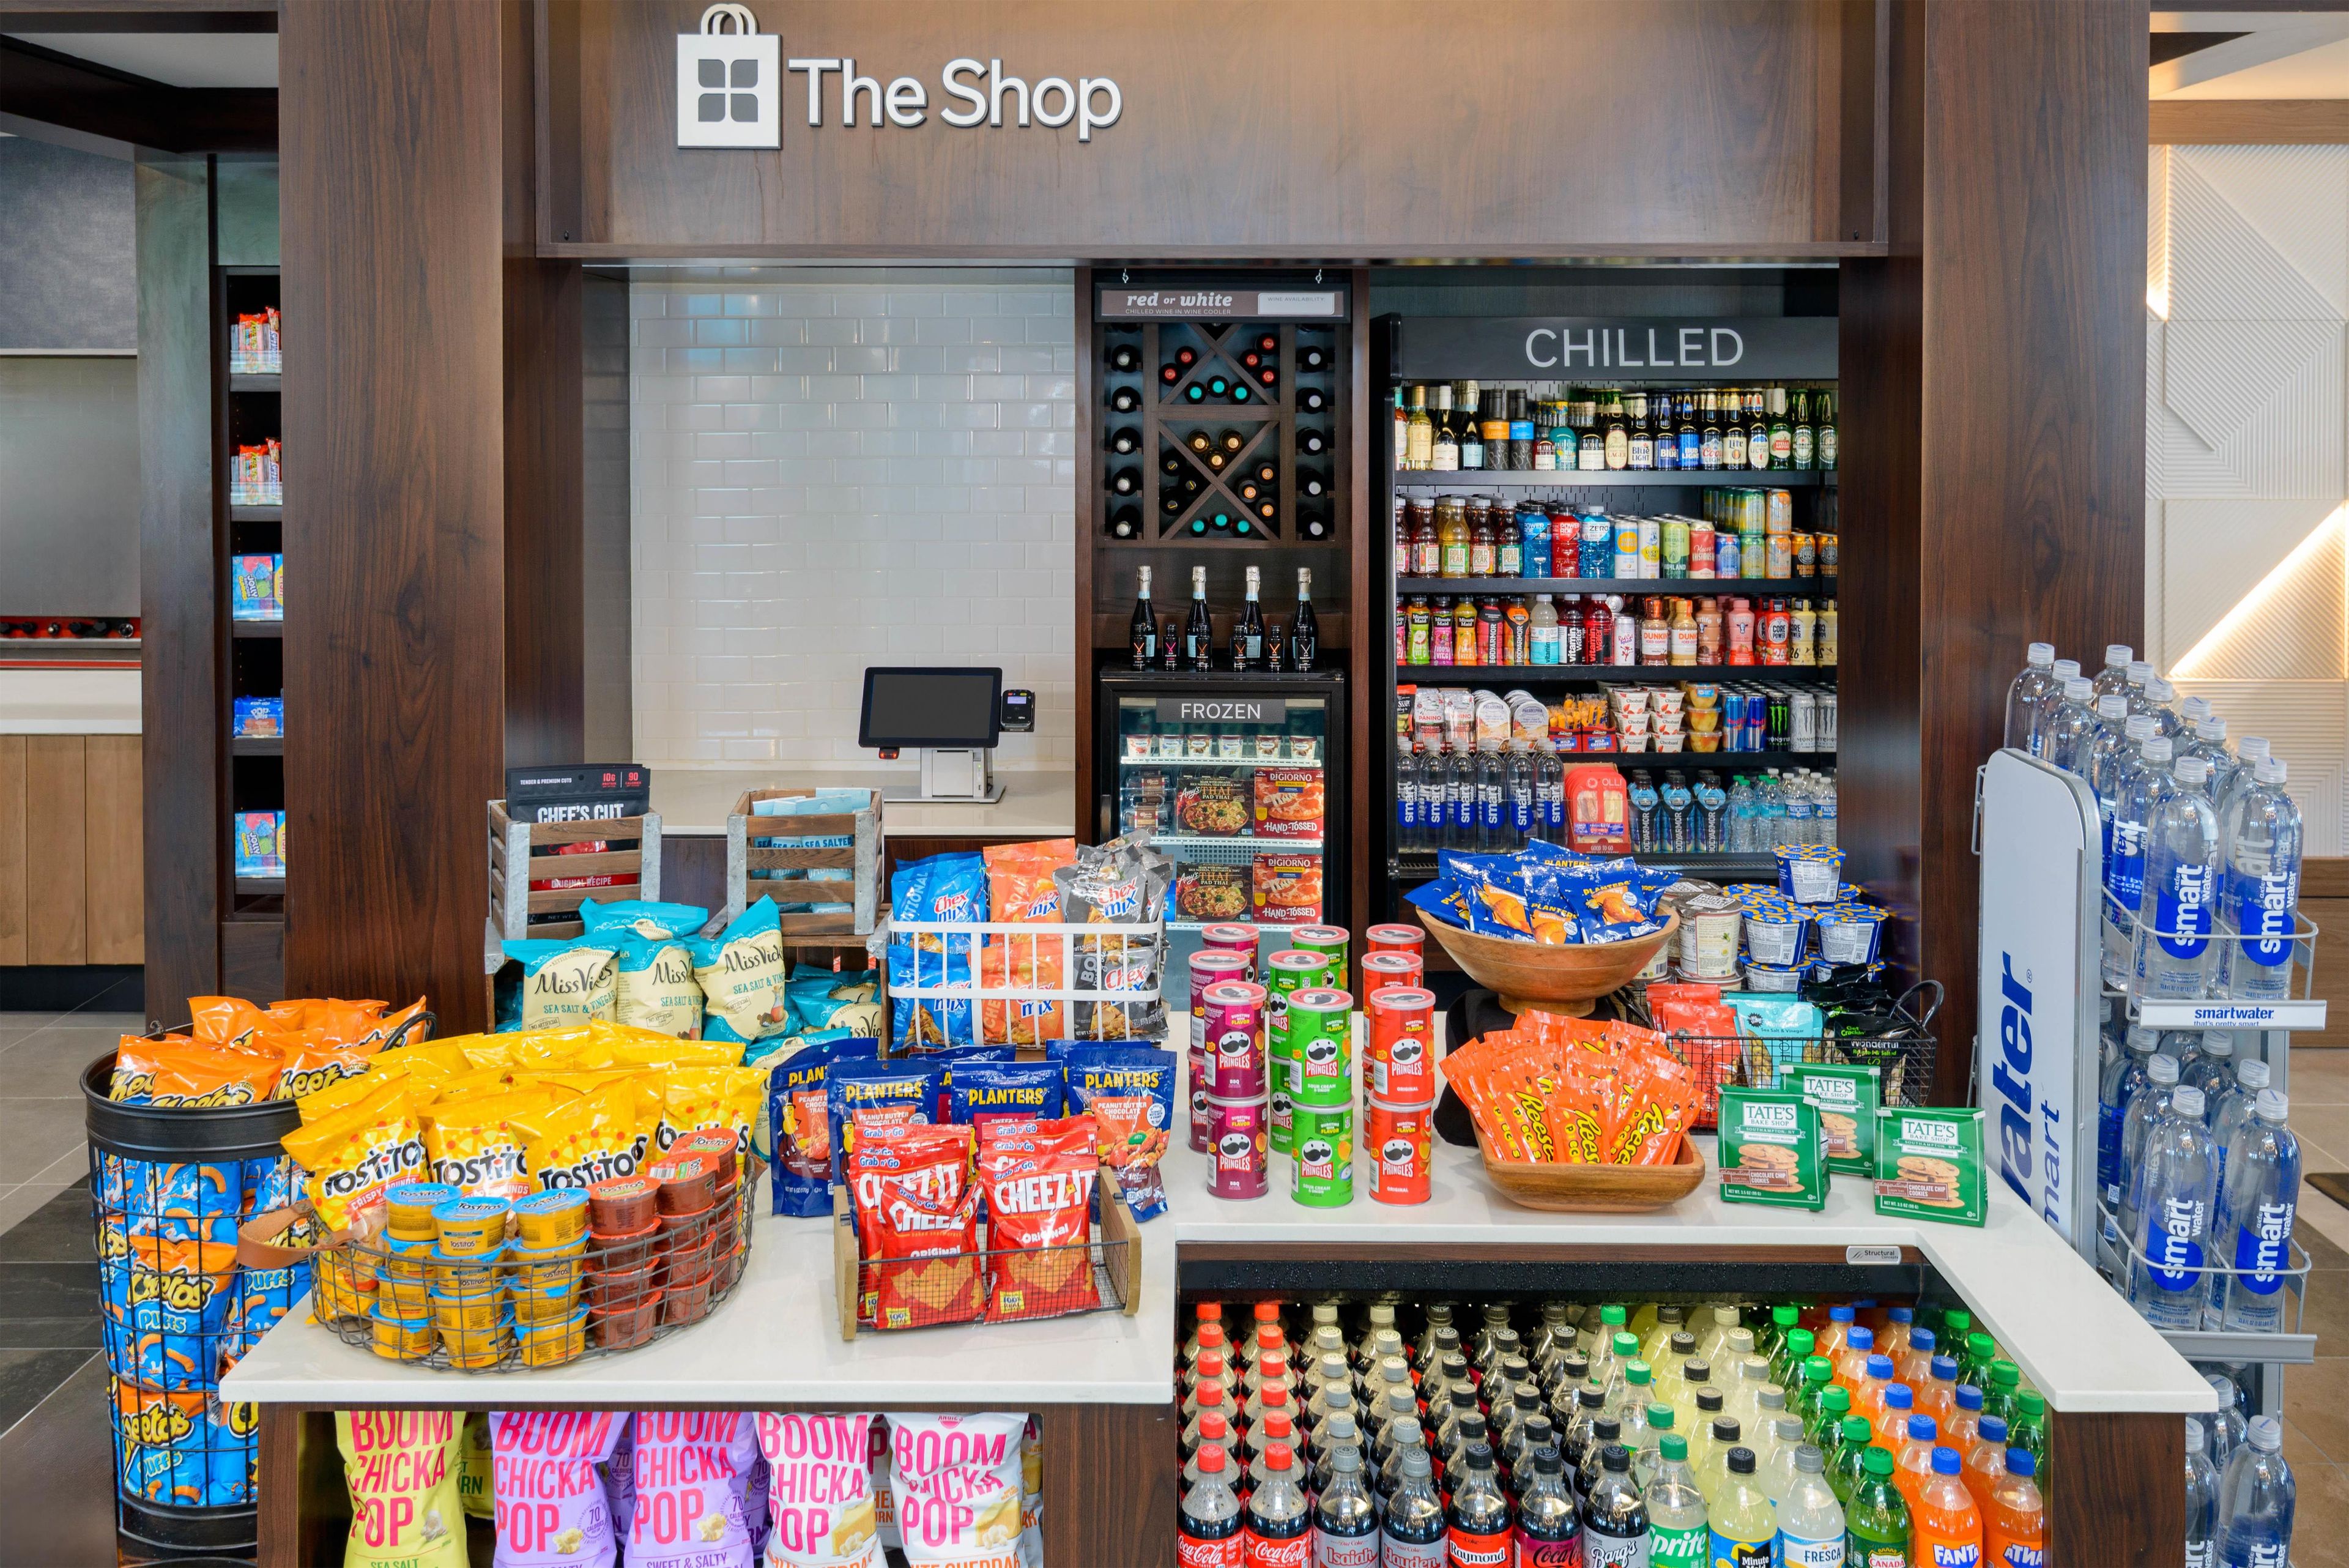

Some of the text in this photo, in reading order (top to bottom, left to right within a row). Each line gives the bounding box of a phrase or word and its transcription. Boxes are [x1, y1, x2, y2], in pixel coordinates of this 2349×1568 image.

[789, 58, 1124, 143] The Shop
[1127, 292, 1159, 307] red
[1180, 292, 1233, 307] white
[1525, 328, 1744, 367] CHILLED
[1632, 446, 1650, 455] Blue
[247, 574, 259, 598] JOLLY
[1181, 703, 1261, 719] FROZEN
[628, 772, 639, 781] 90
[1179, 786, 1201, 801] Amy's
[1201, 786, 1231, 795] THAI
[537, 803, 625, 823] CHEF'S CUT
[249, 831, 261, 855] JOLLY
[551, 876, 612, 889] ORIGINAL RECIPE
[1097, 876, 1138, 905] Chex
[933, 889, 970, 912] Chex
[1025, 896, 1058, 919] mix
[1103, 887, 1139, 918] mix
[534, 973, 577, 995] Miss
[653, 964, 686, 986] Miss
[544, 991, 617, 1014] SEA SALT & VINEGAR
[2194, 1007, 2274, 1020] smartwater
[1219, 1053, 1251, 1069] PRINGLES
[1305, 1060, 1338, 1077] PRINGLES
[1391, 1061, 1423, 1077] PRINGLES
[1085, 1071, 1163, 1091] PLANTERS
[1806, 1078, 1854, 1094] TATE'S
[1993, 950, 2033, 1208] ater
[845, 1082, 923, 1102] PLANTERS
[968, 1087, 1047, 1107] PLANTERS
[1097, 1101, 1148, 1110] PEANUT BUTTER
[1746, 1105, 1795, 1121] TATE'S
[1614, 1102, 1664, 1165] Reese
[1904, 1121, 1956, 1139] TATE'S
[1219, 1155, 1251, 1172] PRINGLES
[1301, 1161, 1333, 1179] PRINGLES
[351, 1189, 384, 1210] CRISPY
[897, 1187, 916, 1203] Grab
[922, 1200, 938, 1211] Go
[2163, 1197, 2194, 1279] smart
[2191, 1200, 2205, 1236] water
[2255, 1202, 2286, 1283] smart
[2282, 1202, 2294, 1239] water
[350, 1411, 454, 1453] BOOM
[497, 1411, 615, 1457] BOOM
[616, 1452, 631, 1467] 70
[896, 1425, 1008, 1477] BOOM
[349, 1446, 447, 1493] CHICKA
[495, 1456, 596, 1499] CHICKA
[636, 1446, 737, 1489] CHICKA
[351, 1496, 414, 1548] POP
[587, 1519, 606, 1534] CALORIES
[589, 1507, 601, 1525] 70
[634, 1487, 704, 1545] POP
[902, 1495, 974, 1547] POP
[1178, 1534, 1225, 1564] Coca-Cola
[1255, 1537, 1308, 1564] Coca-Cola
[1464, 1536, 1479, 1545] Coke
[685, 1558, 694, 1568] &
[696, 1551, 727, 1567] SALTY
[1326, 1547, 1377, 1566] Isaiah
[1383, 1545, 1441, 1568] Hayden
[1450, 1542, 1506, 1564] Raymond
[1591, 1540, 1637, 1568] Barq's
[1742, 1556, 1770, 1566] Minute
[1804, 1548, 1842, 1563] FRESCA
[1868, 1557, 1906, 1568] CANADA
[1932, 1543, 1980, 1567] FANTA
